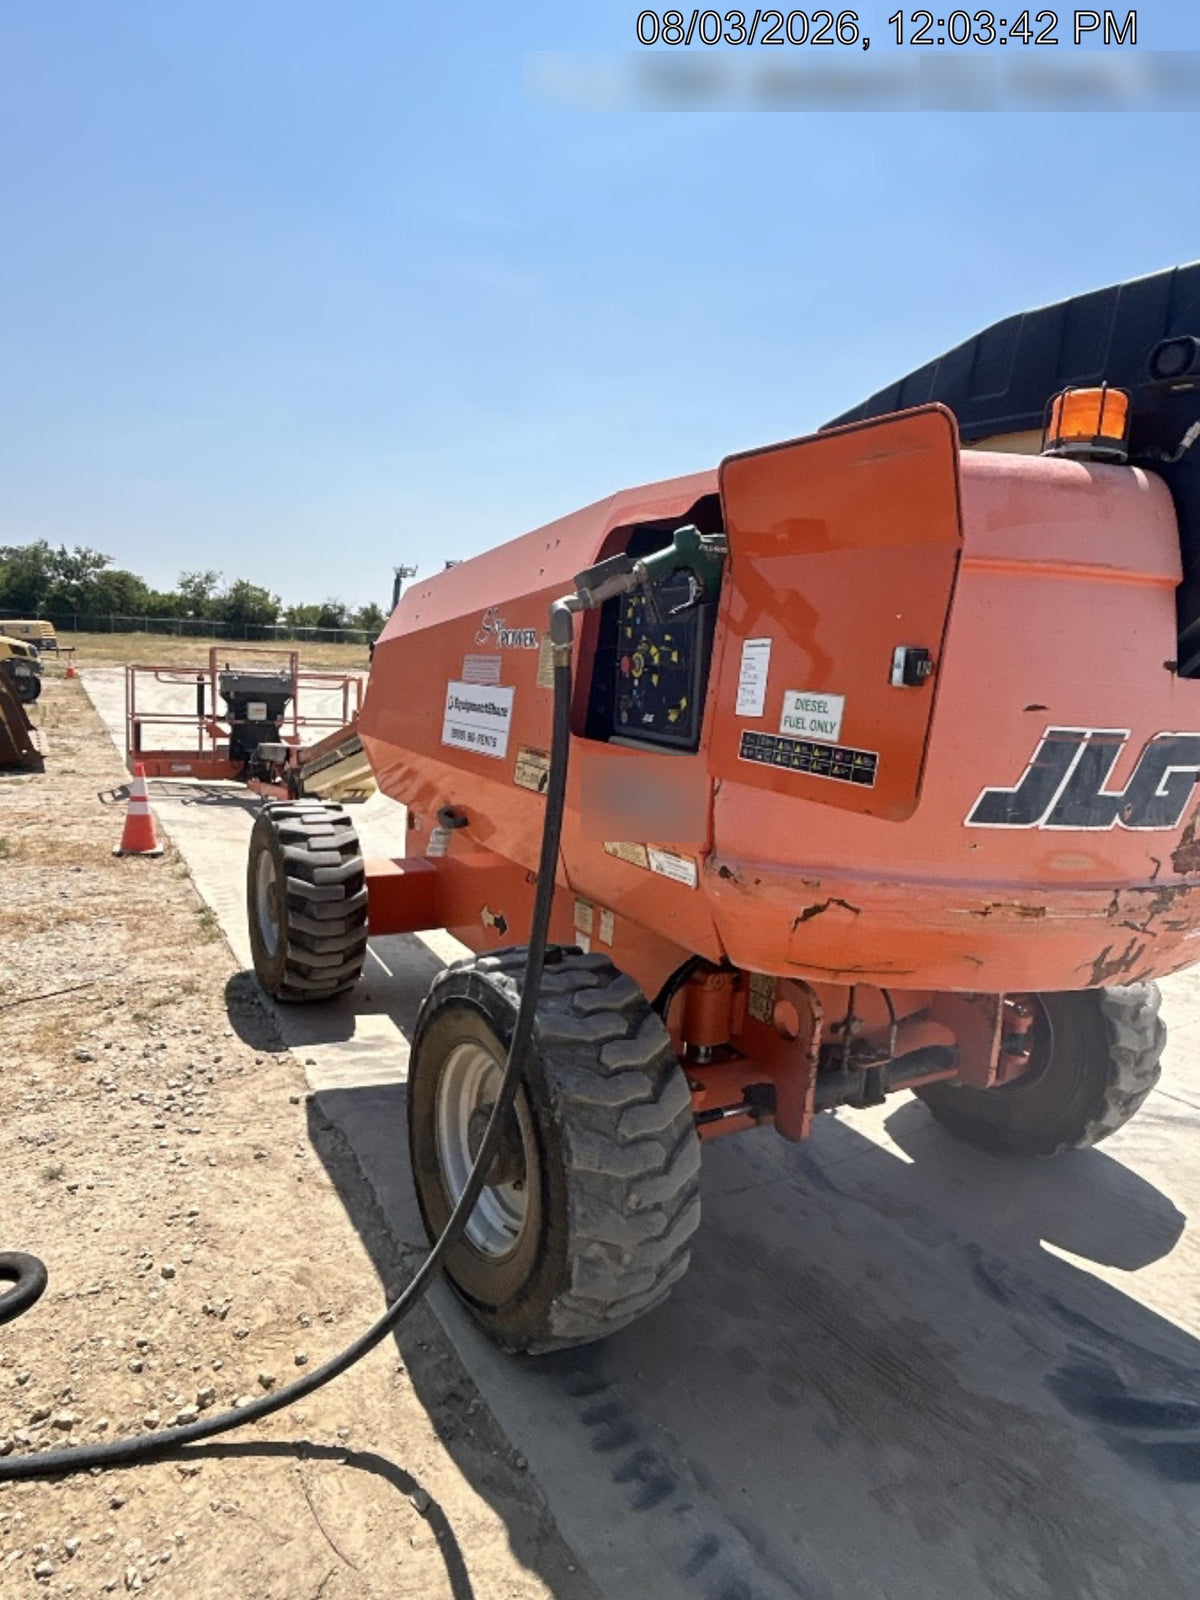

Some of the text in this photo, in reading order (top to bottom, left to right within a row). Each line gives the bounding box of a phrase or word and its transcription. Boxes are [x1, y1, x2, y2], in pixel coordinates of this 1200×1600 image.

[794, 697, 829, 714] DIESEL
[783, 715, 836, 734] FUEL ONLY
[963, 726, 1200, 831] JLG
